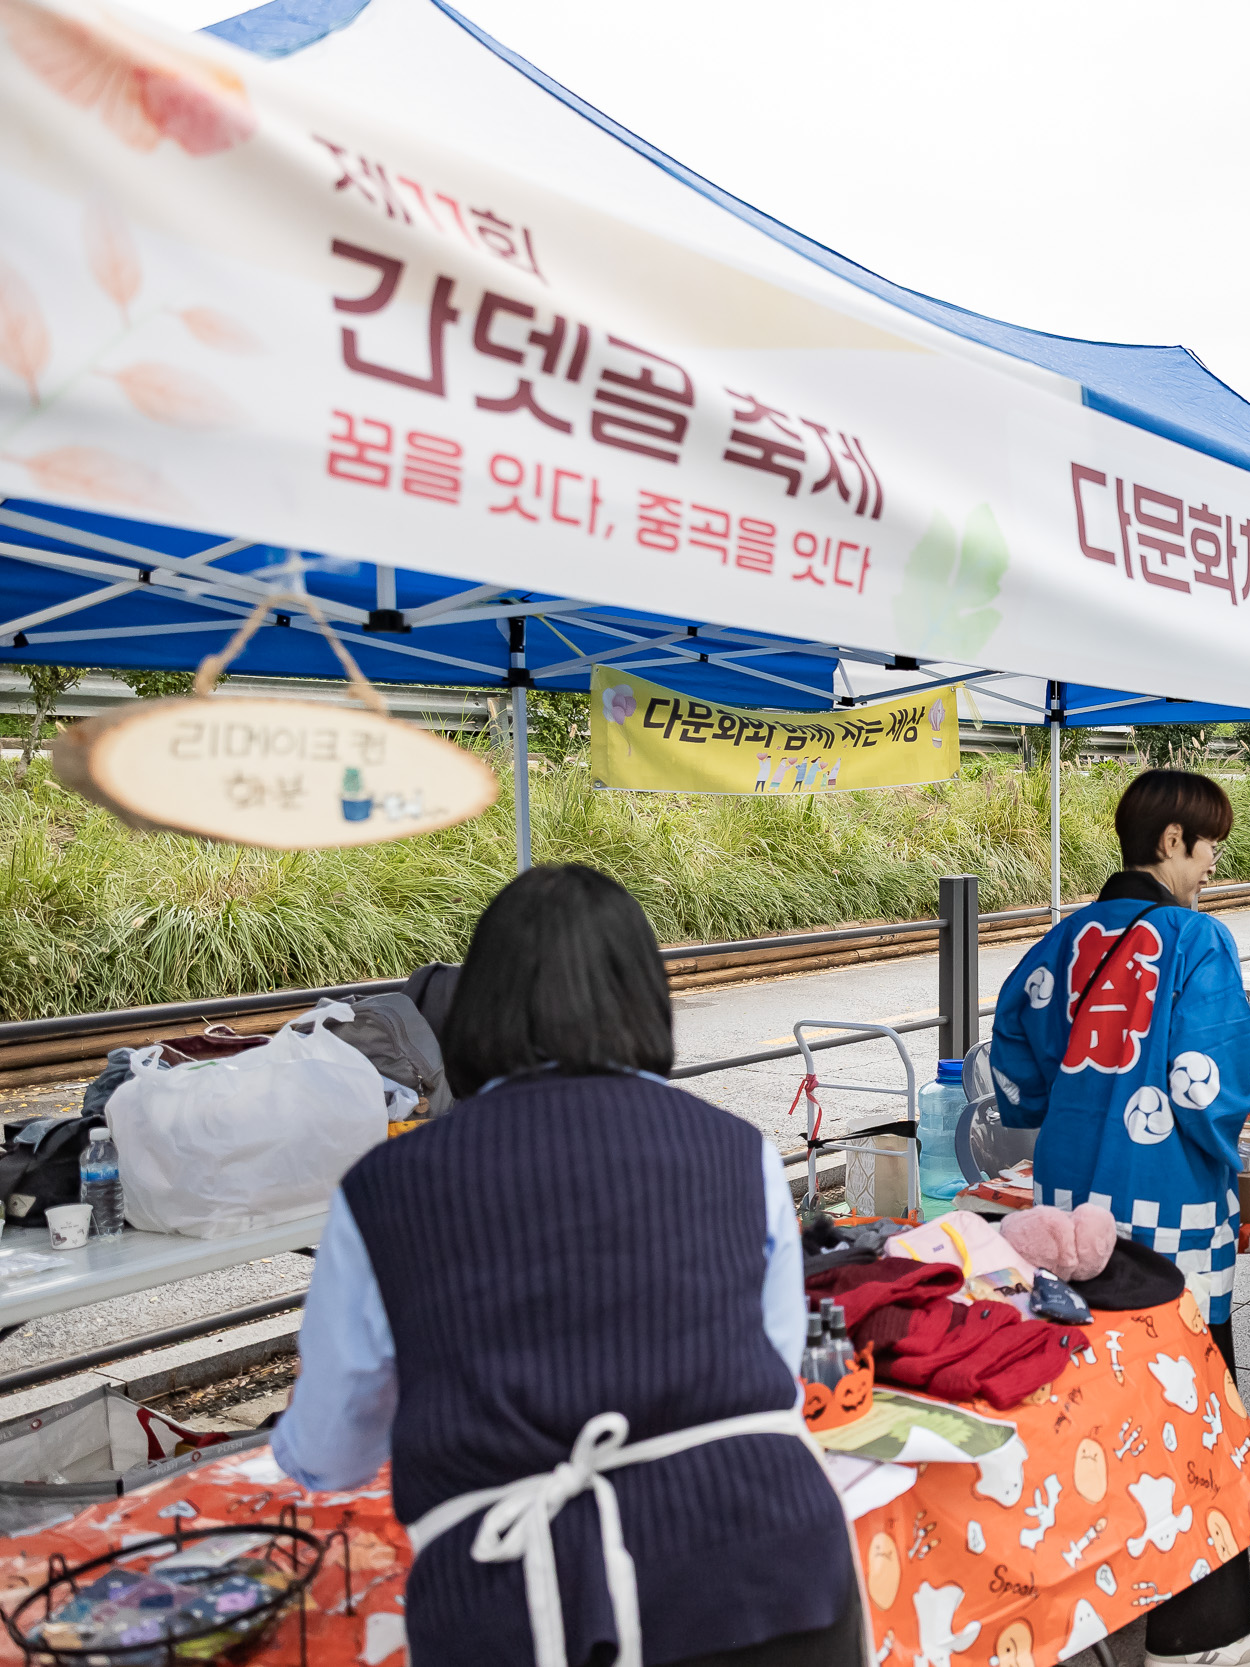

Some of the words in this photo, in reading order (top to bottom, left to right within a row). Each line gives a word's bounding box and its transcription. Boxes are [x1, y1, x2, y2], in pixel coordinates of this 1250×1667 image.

[331, 238, 697, 464] 간뎃골
[723, 387, 885, 521] 축제
[326, 409, 463, 505] 꿈을
[488, 452, 614, 541] 잇다,
[636, 489, 777, 575] 중곡을
[791, 530, 872, 595] 잇다
[643, 697, 777, 748] 다문화와
[772, 721, 835, 750] 함께
[834, 719, 884, 747] 사는
[886, 706, 926, 742] 세상
